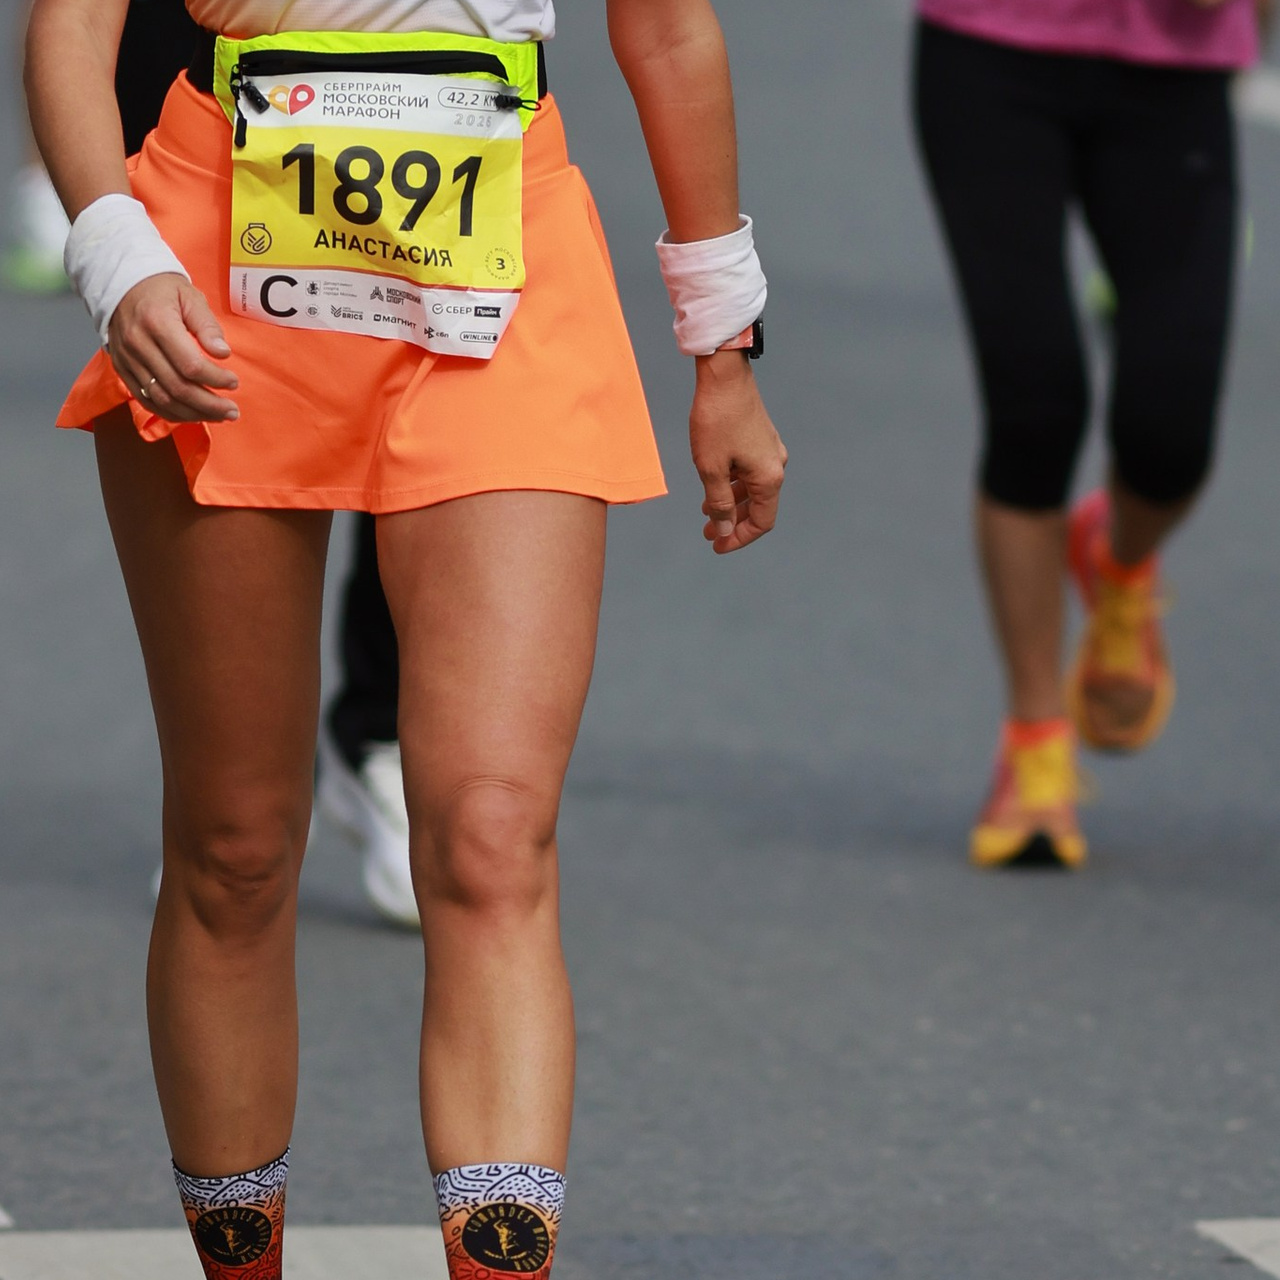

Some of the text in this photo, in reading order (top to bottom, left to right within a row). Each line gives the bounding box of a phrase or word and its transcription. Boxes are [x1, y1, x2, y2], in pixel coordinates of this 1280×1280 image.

[323, 81, 402, 93] СБЕРПРАЙМ
[323, 93, 429, 109] МОСКОВСКИЙ
[447, 92, 480, 107] 42,2
[322, 105, 401, 120] МАРАФОН
[281, 143, 483, 237] 1891
[313, 229, 453, 268] АНАСТАСИЯ
[495, 257, 506, 271] 3
[386, 295, 404, 305] СПОРТ
[342, 312, 363, 321] BRICS
[446, 305, 472, 314] СБЕР
[463, 333, 492, 341] WINLINE
